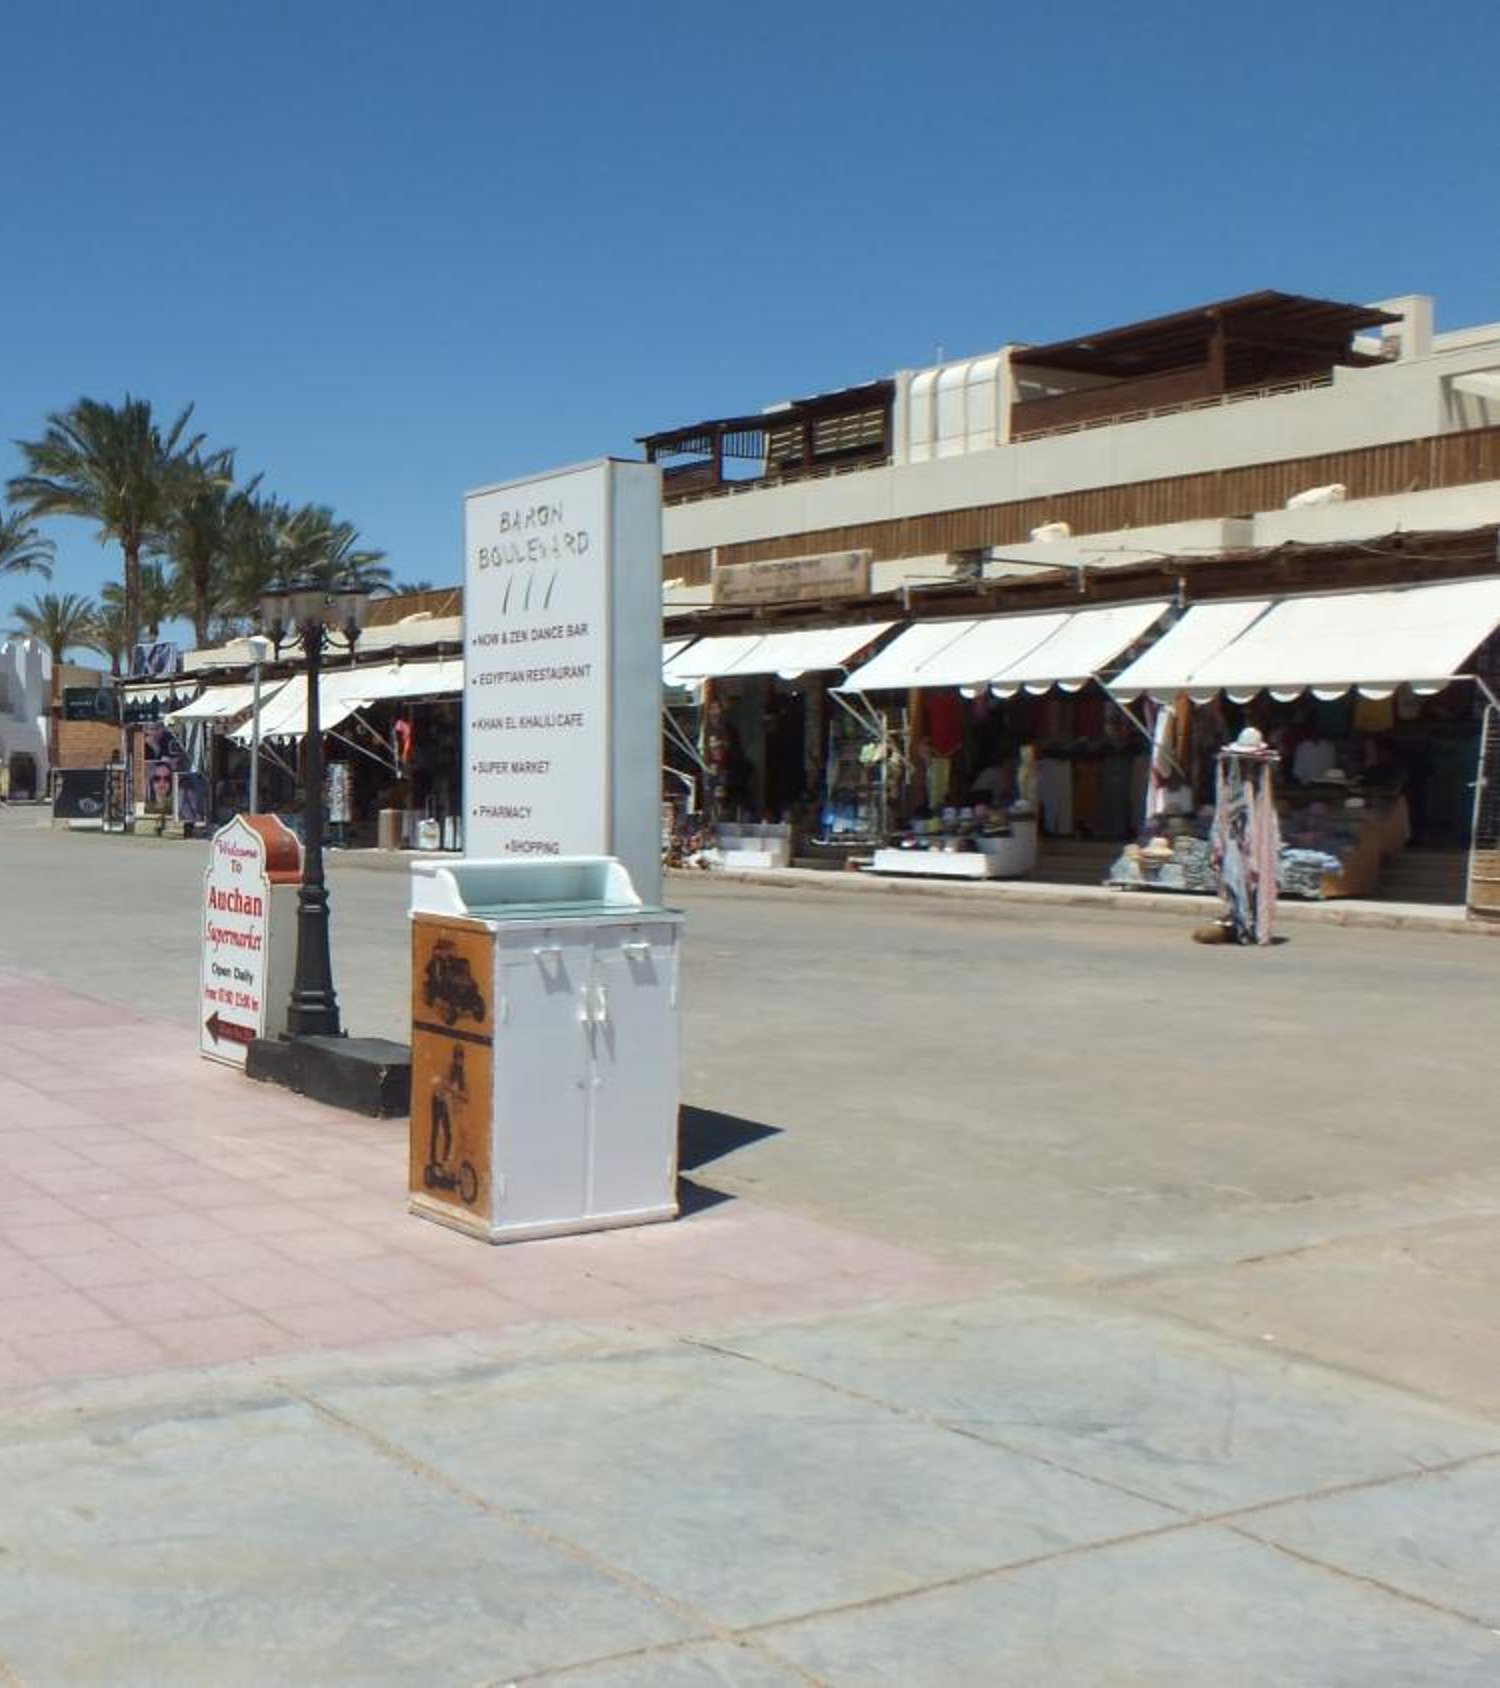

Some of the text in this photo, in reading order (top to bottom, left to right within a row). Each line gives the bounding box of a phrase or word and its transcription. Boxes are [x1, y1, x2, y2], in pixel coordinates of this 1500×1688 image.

[500, 503, 563, 534] BARON
[531, 625, 564, 641] DANCE
[567, 623, 588, 637] BAR
[479, 664, 591, 685] EGYPTIAN RESTAURANT
[478, 717, 503, 730] KHAN
[506, 716, 517, 729] EL
[557, 713, 584, 727] CAFE
[478, 761, 549, 774] SUPER MARKET
[479, 805, 532, 819] PHARMACY
[510, 840, 560, 855] SHOPPING
[231, 859, 243, 874] To
[208, 885, 263, 918] Auchan
[206, 920, 262, 953] Supermarket
[211, 962, 254, 987] Open Daily
